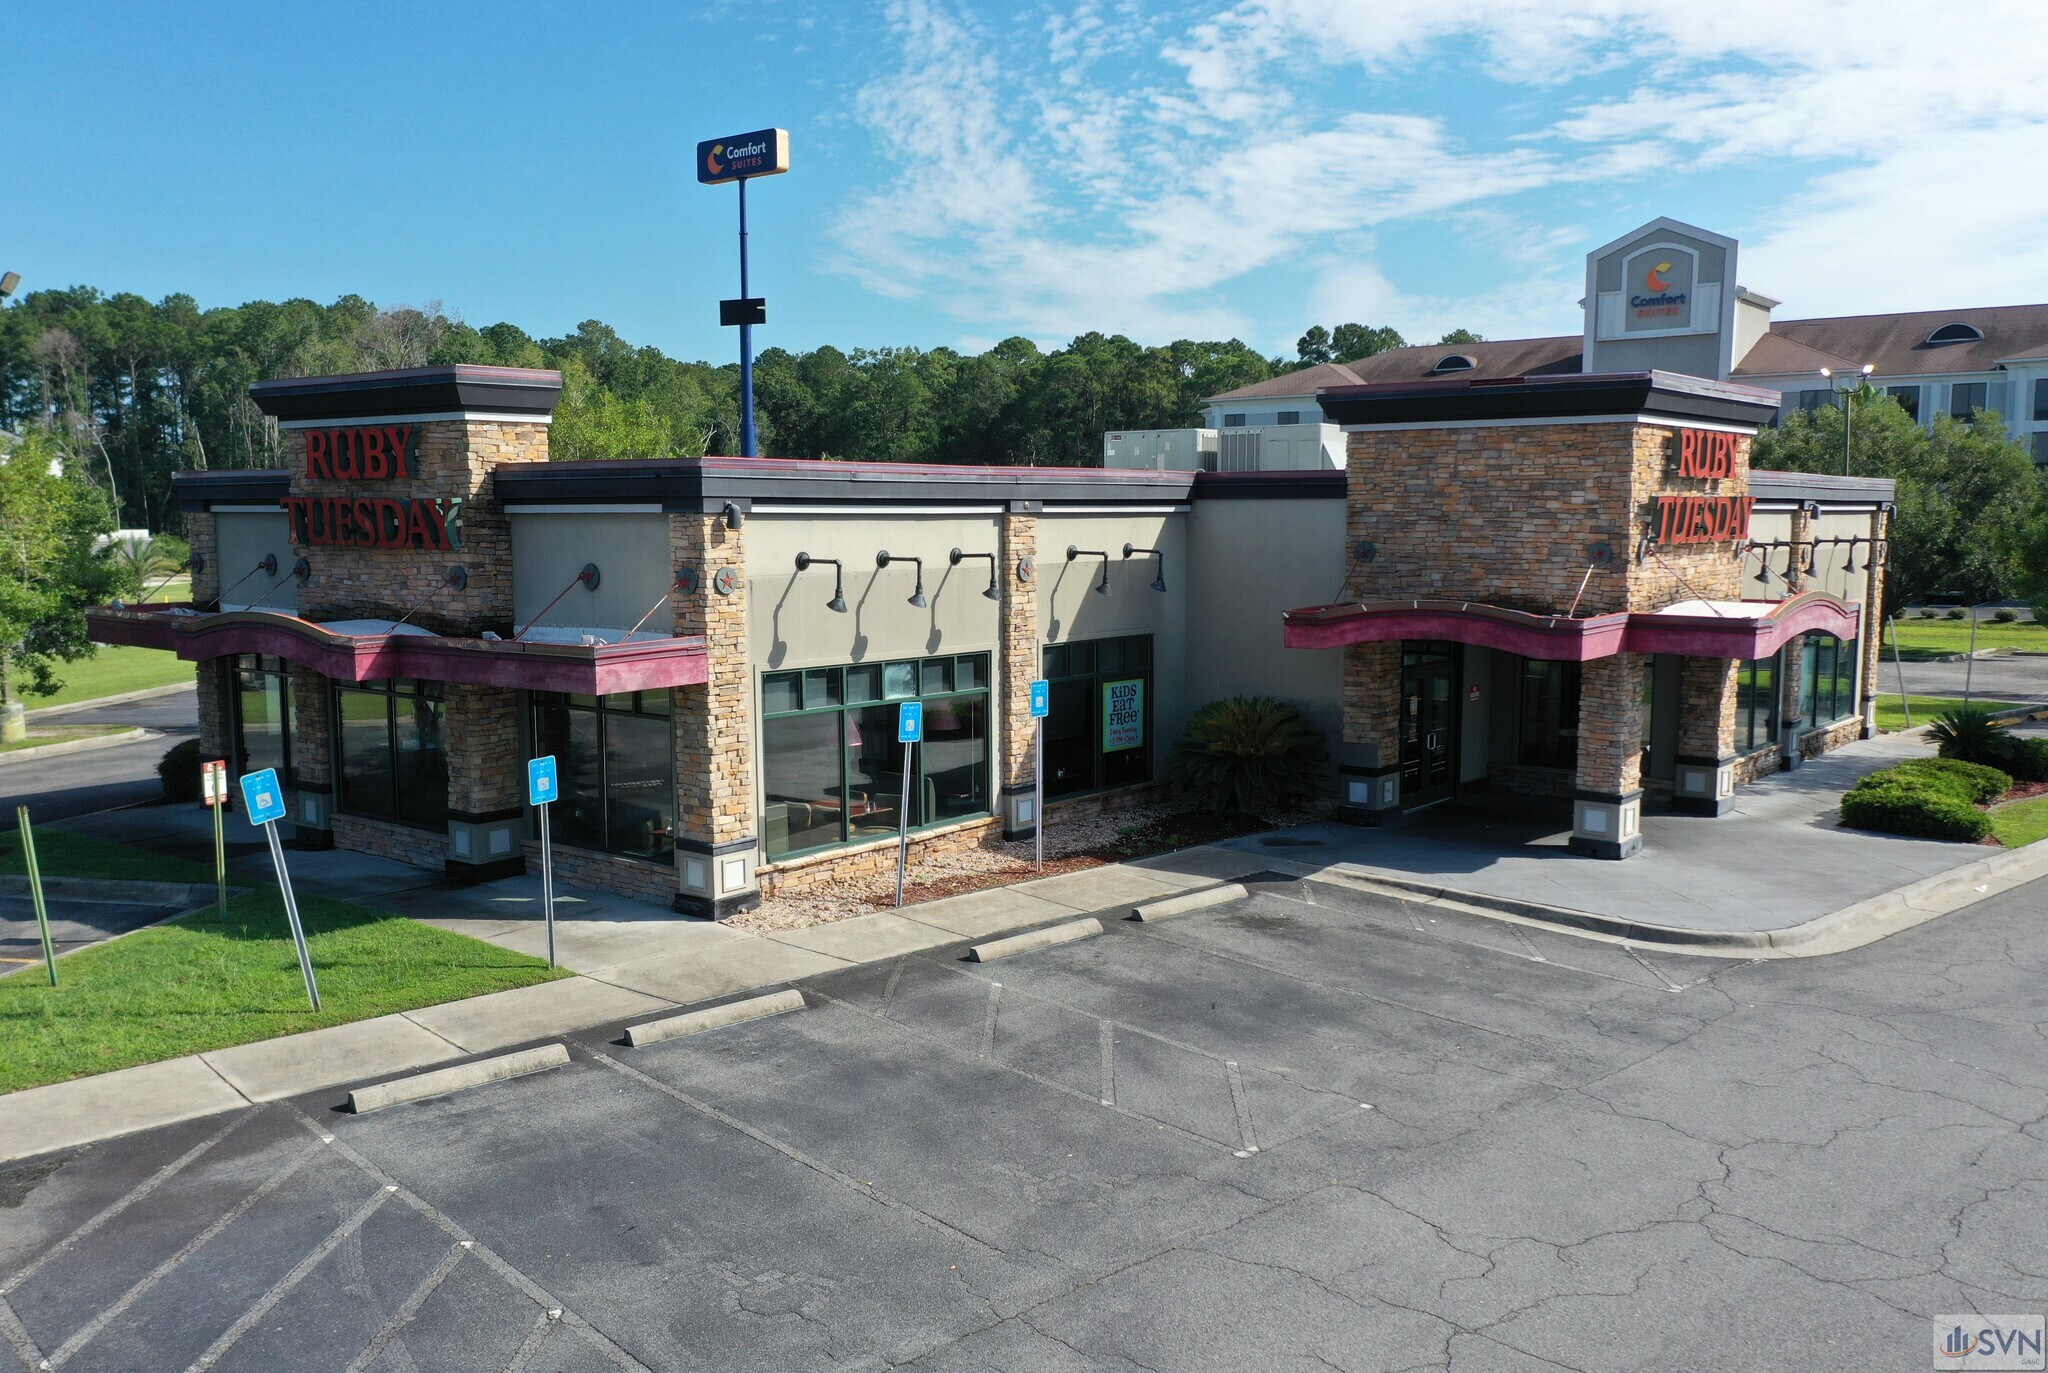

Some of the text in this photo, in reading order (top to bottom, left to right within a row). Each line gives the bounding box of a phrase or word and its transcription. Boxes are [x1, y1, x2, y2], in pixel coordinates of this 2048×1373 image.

[727, 142, 766, 159] Comfort
[732, 157, 762, 170] SUITES
[1631, 293, 1686, 307] Comfort
[304, 426, 412, 480] RUBY
[1678, 429, 1744, 479] RUBY
[280, 497, 457, 551] TUESDAY
[1657, 496, 1756, 545] TUESDAY
